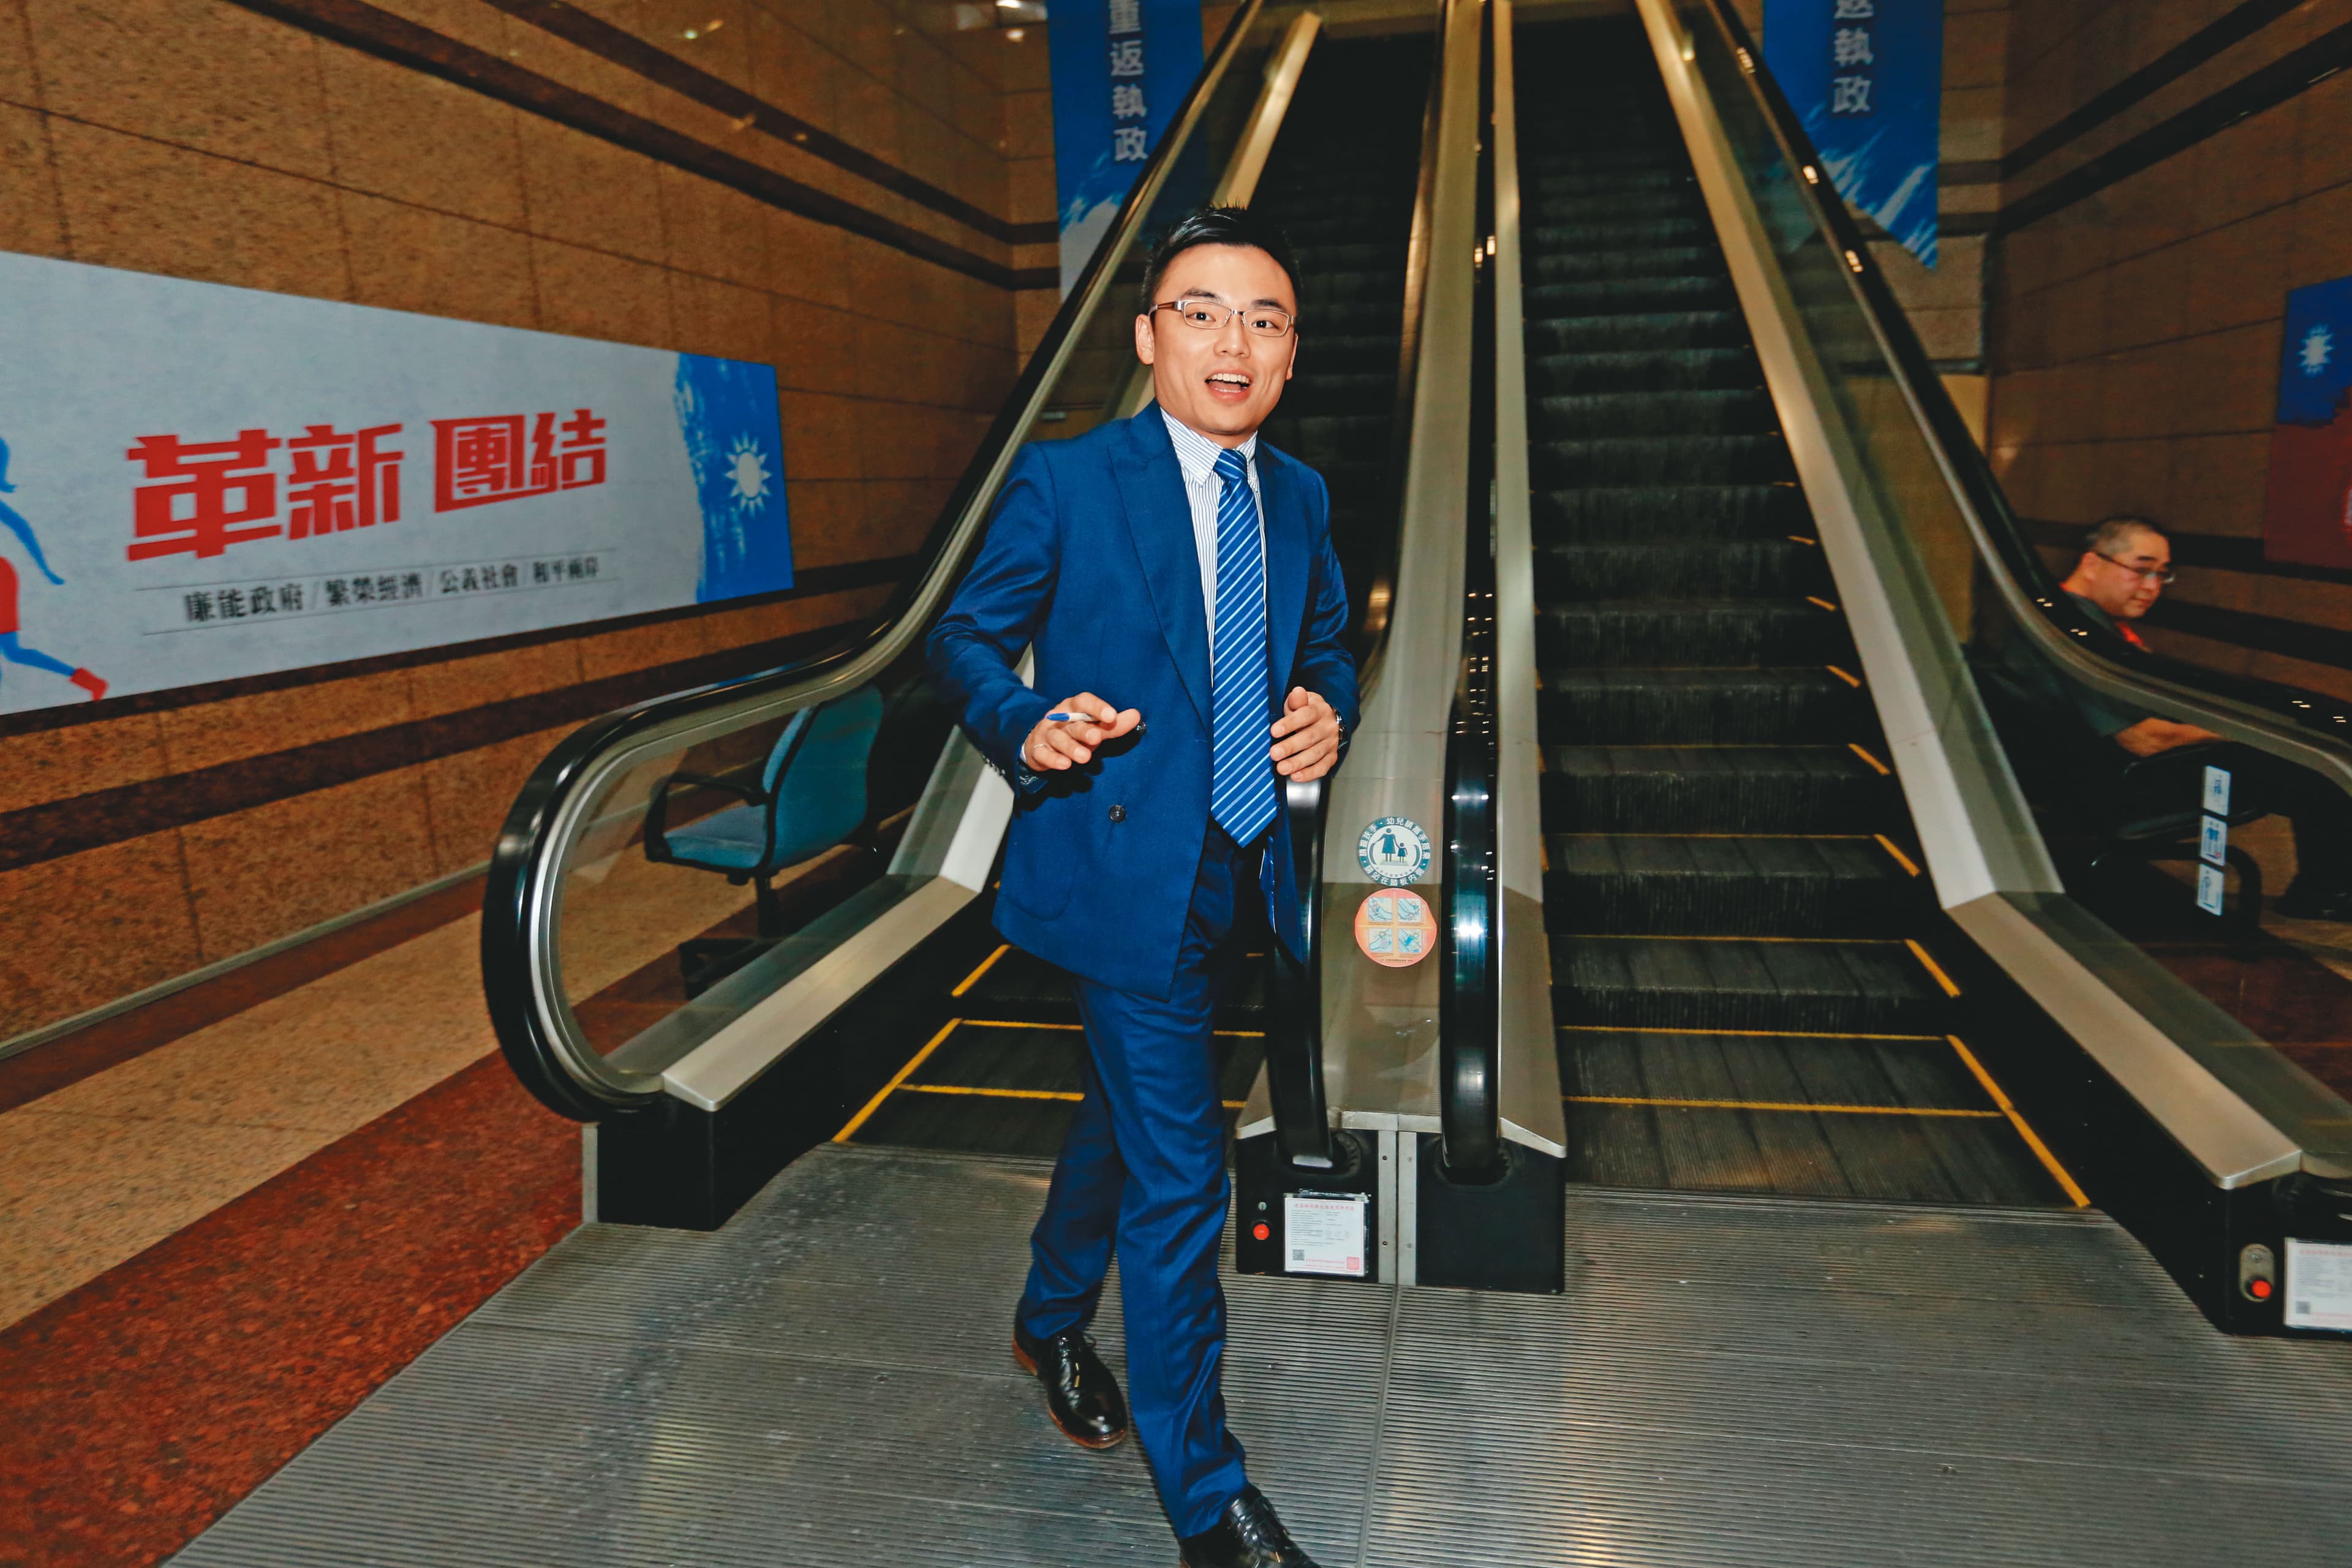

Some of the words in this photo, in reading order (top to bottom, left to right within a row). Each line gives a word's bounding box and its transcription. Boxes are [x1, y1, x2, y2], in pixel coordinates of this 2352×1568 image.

[1108, 0, 1148, 161] 重返執政
[126, 424, 404, 561] 革新
[429, 409, 606, 513] 團結
[184, 582, 303, 622] 廉能政府
[325, 572, 423, 607] 繁榮經濟
[439, 562, 519, 594] 公義社會
